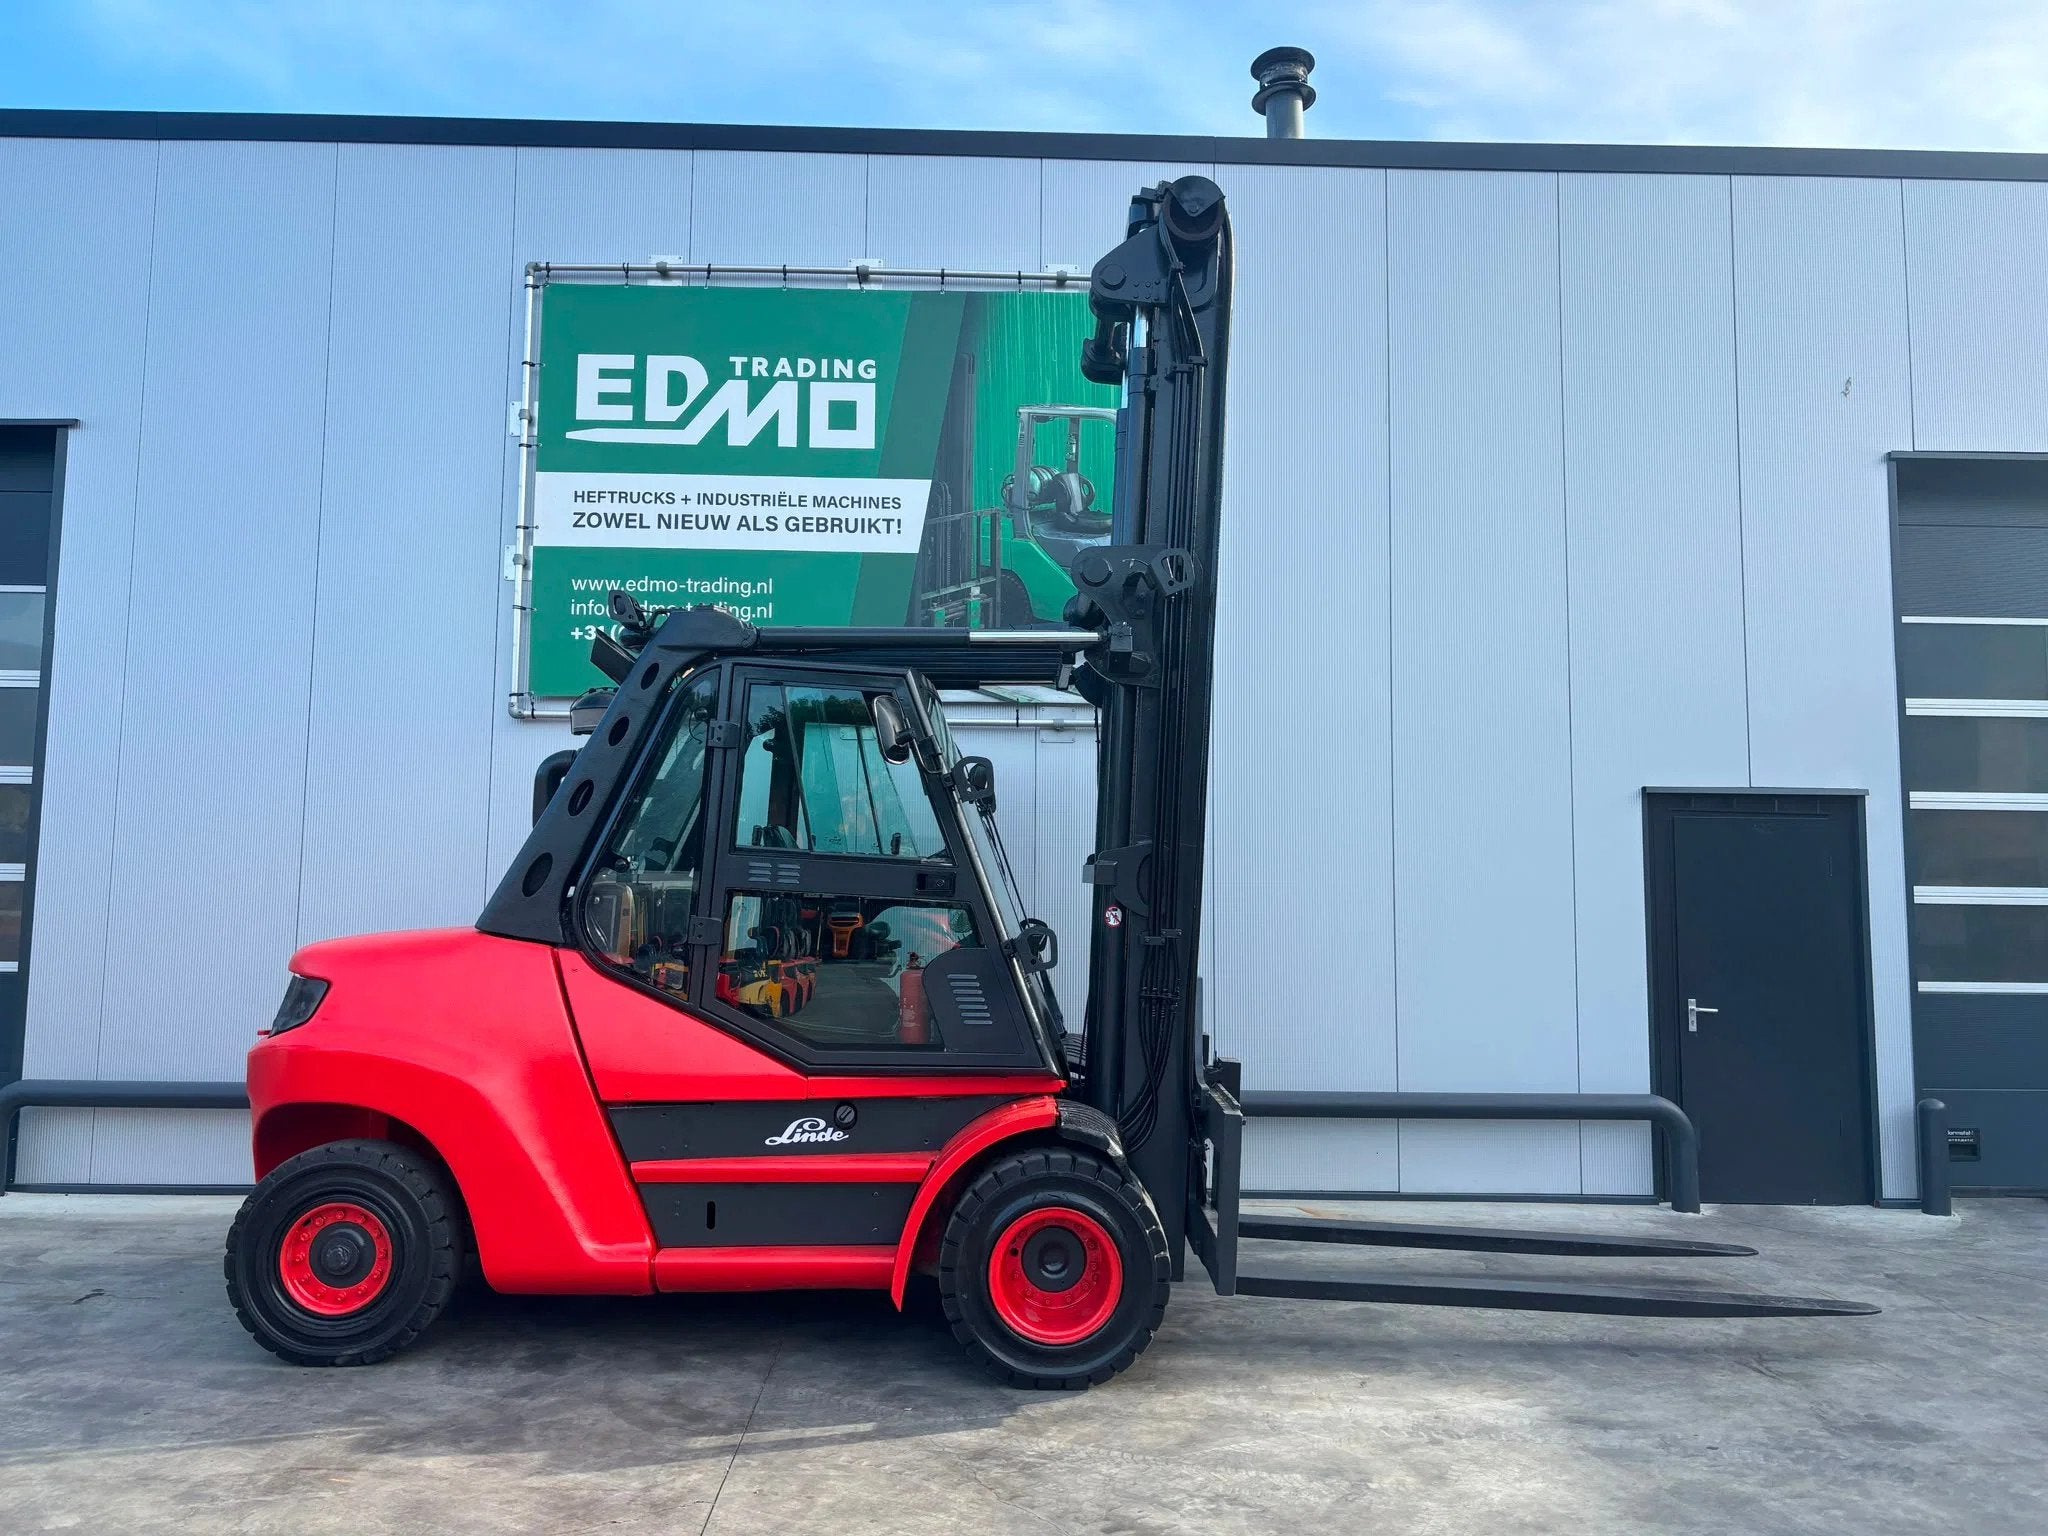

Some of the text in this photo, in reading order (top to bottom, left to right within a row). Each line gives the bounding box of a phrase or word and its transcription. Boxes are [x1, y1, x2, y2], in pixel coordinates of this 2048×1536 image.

[729, 356, 876, 379] TRADING
[566, 354, 876, 449] EDMO
[573, 490, 902, 509] HEFTRUCKS + INDUSTRIËLE MACHINES
[572, 511, 902, 534] ZOWEL NIEUW ALS GEBRUIKT!
[571, 576, 773, 598] www.edmo-trading.nl
[765, 1117, 850, 1146] Linde
